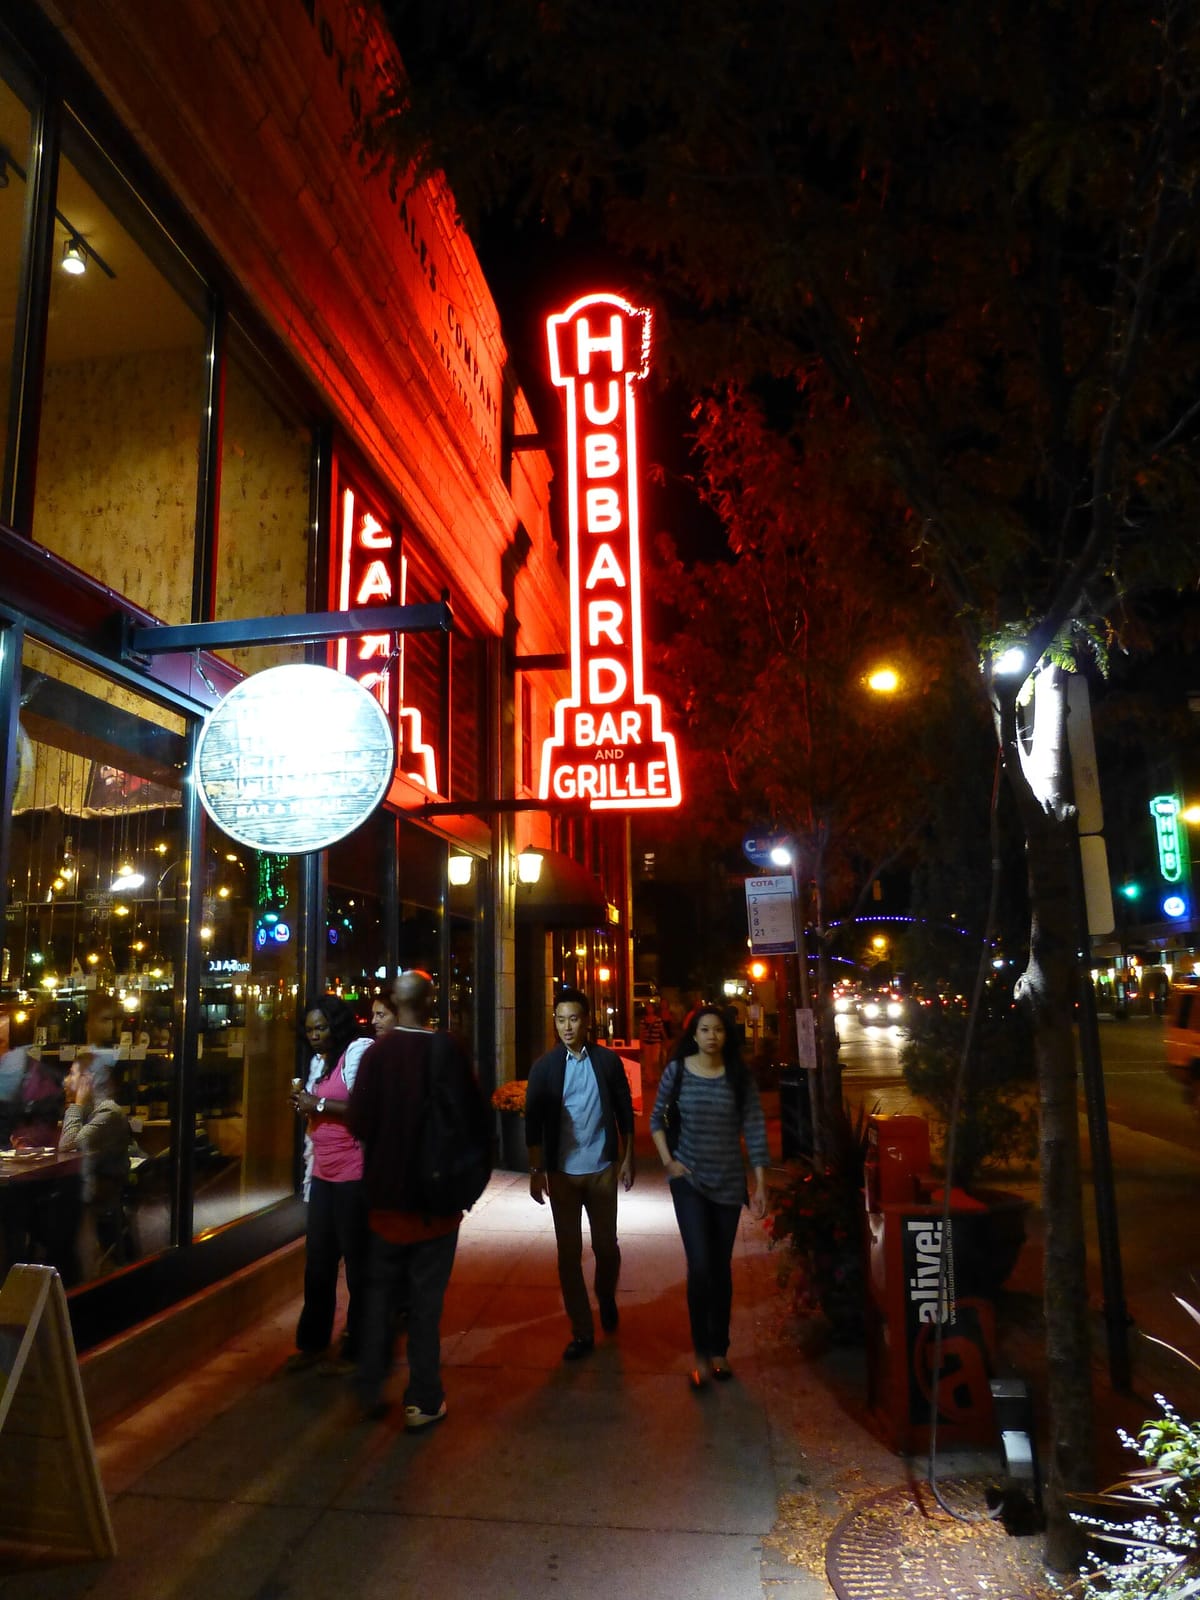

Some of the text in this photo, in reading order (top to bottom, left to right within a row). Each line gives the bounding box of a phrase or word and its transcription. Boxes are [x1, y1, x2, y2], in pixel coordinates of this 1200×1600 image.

[447, 303, 498, 428] COMPANY
[576, 314, 628, 705] HUBBARD
[575, 711, 642, 747] BAR
[594, 749, 625, 760] AND
[553, 761, 667, 799] GRILLE
[750, 880, 774, 888] COTA
[752, 897, 758, 905] 2
[753, 918, 760, 926] 8
[754, 929, 765, 937] 21
[907, 1221, 946, 1324] alive!
